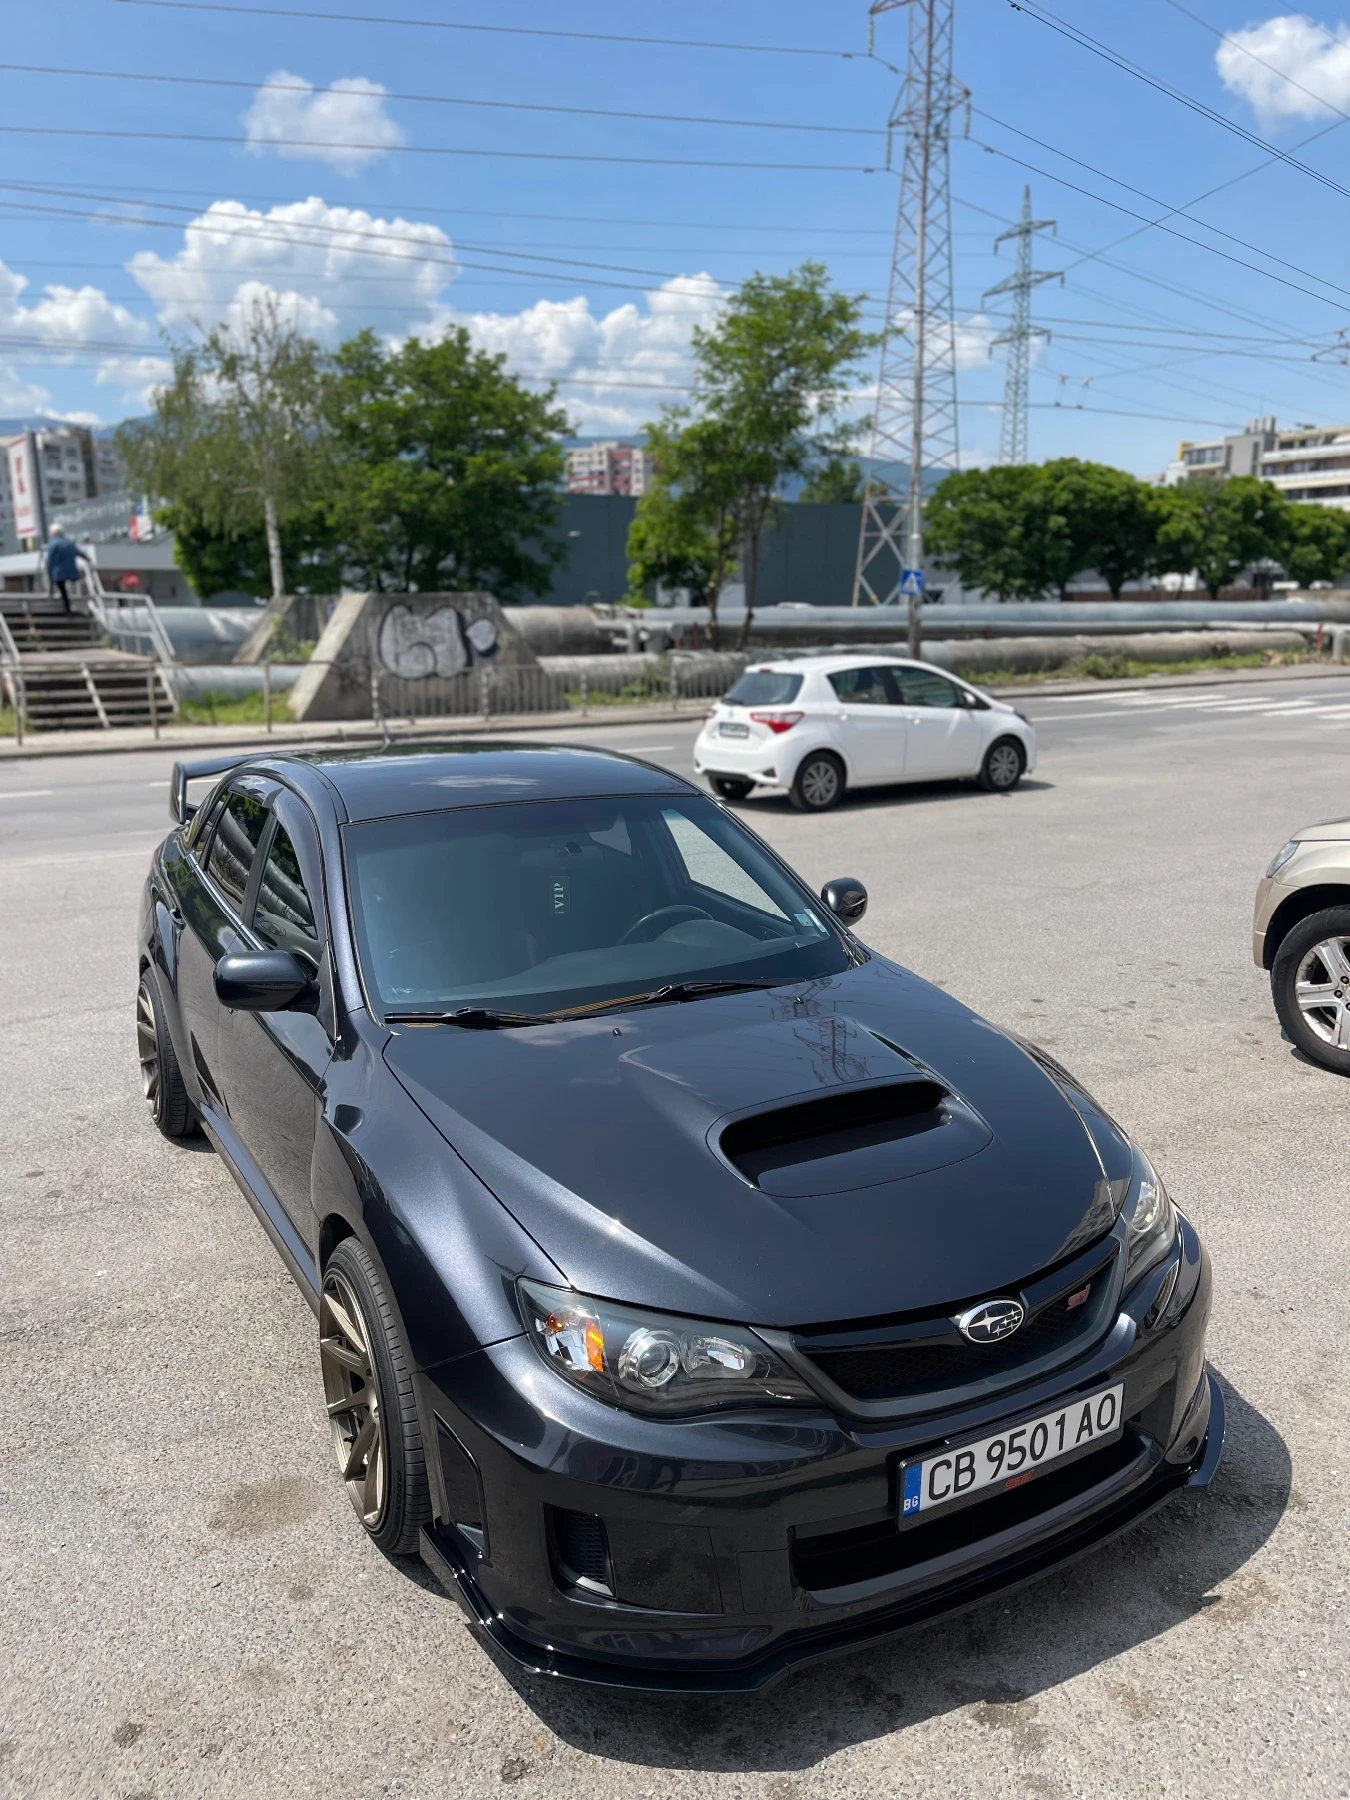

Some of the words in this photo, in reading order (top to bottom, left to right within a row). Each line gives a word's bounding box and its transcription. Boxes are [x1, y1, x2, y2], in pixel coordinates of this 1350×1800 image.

[554, 882, 565, 910] VIP
[928, 1450, 976, 1501] CB
[986, 1412, 1067, 1480] 9501
[1075, 1393, 1116, 1444] AO
[903, 1496, 919, 1512] BG
